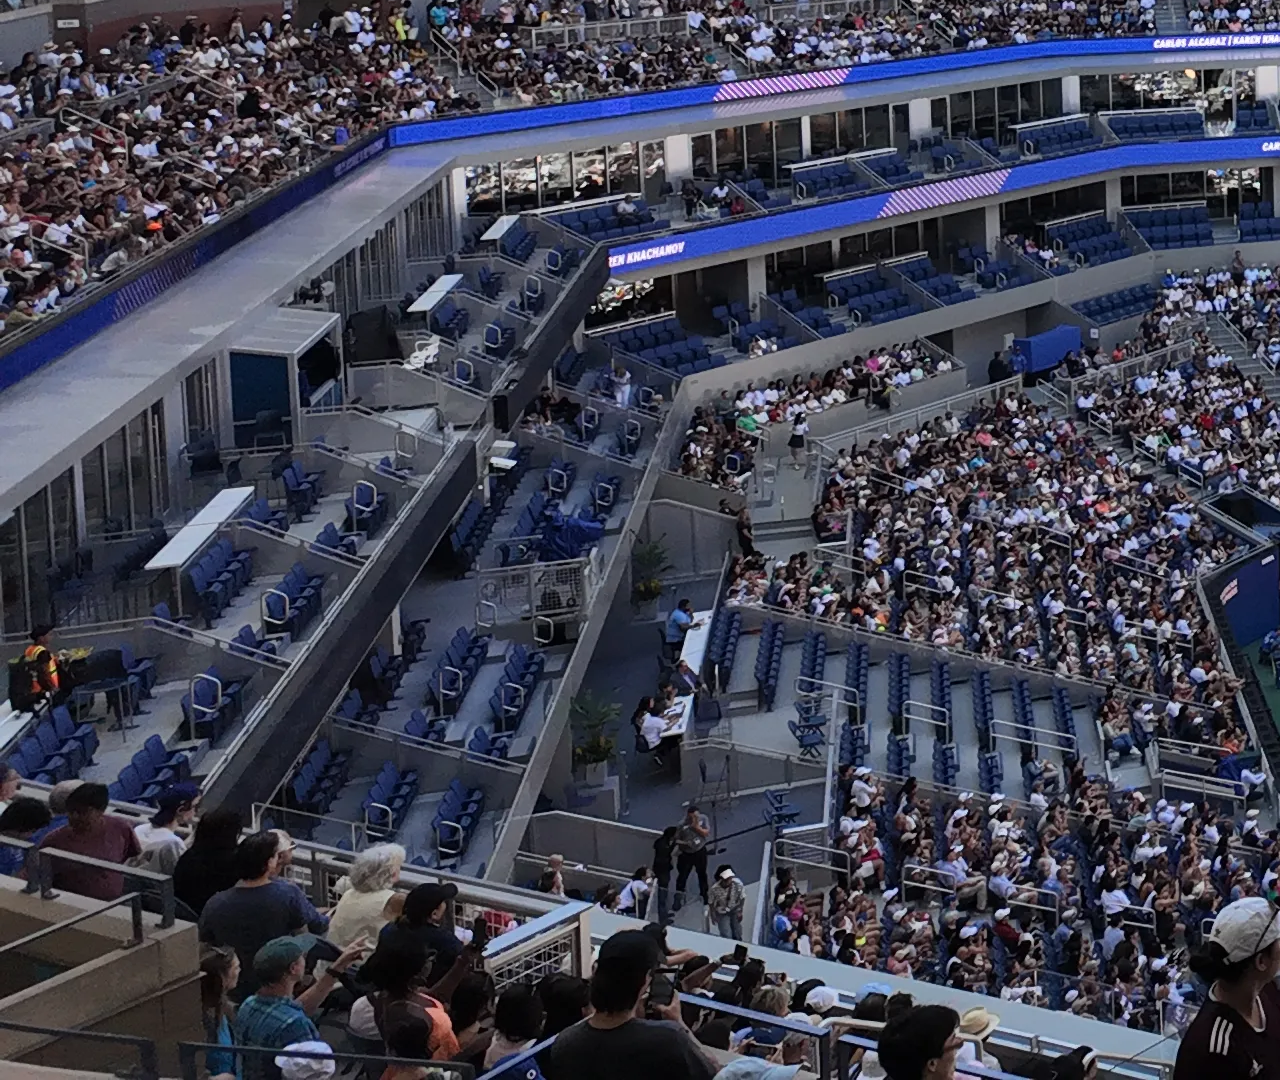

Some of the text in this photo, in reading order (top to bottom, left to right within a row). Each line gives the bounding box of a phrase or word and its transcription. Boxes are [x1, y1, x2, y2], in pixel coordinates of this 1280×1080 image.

[1153, 37, 1187, 49] CARLOS
[1188, 36, 1227, 47] ALCARAZ
[1232, 35, 1262, 45] KAREN
[626, 241, 685, 264] KHACHANOV
